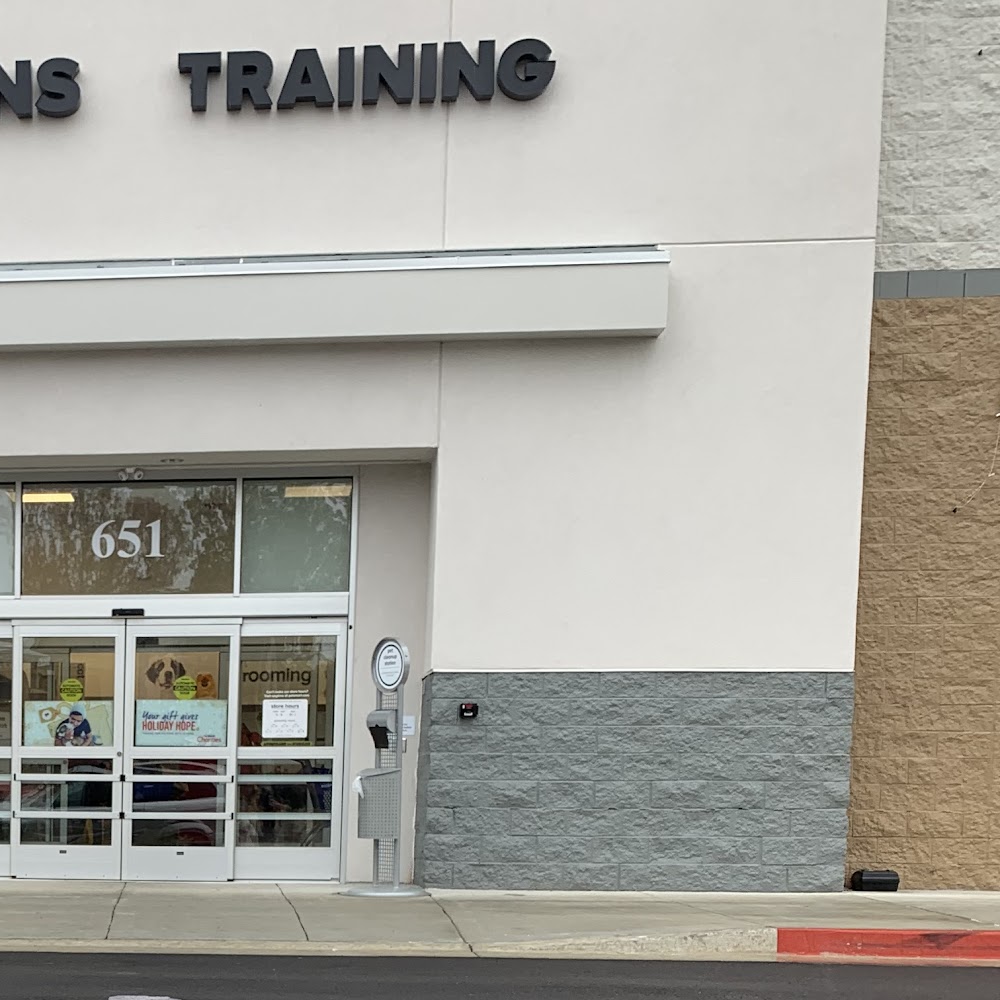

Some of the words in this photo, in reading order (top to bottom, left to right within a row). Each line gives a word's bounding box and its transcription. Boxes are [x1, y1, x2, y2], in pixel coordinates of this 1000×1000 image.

[178, 38, 556, 111] TRAINING
[91, 519, 165, 559] 651
[142, 710, 160, 720] Your
[162, 710, 178, 721] gift
[180, 713, 199, 722] gives
[142, 721, 174, 731] HOLIDAY
